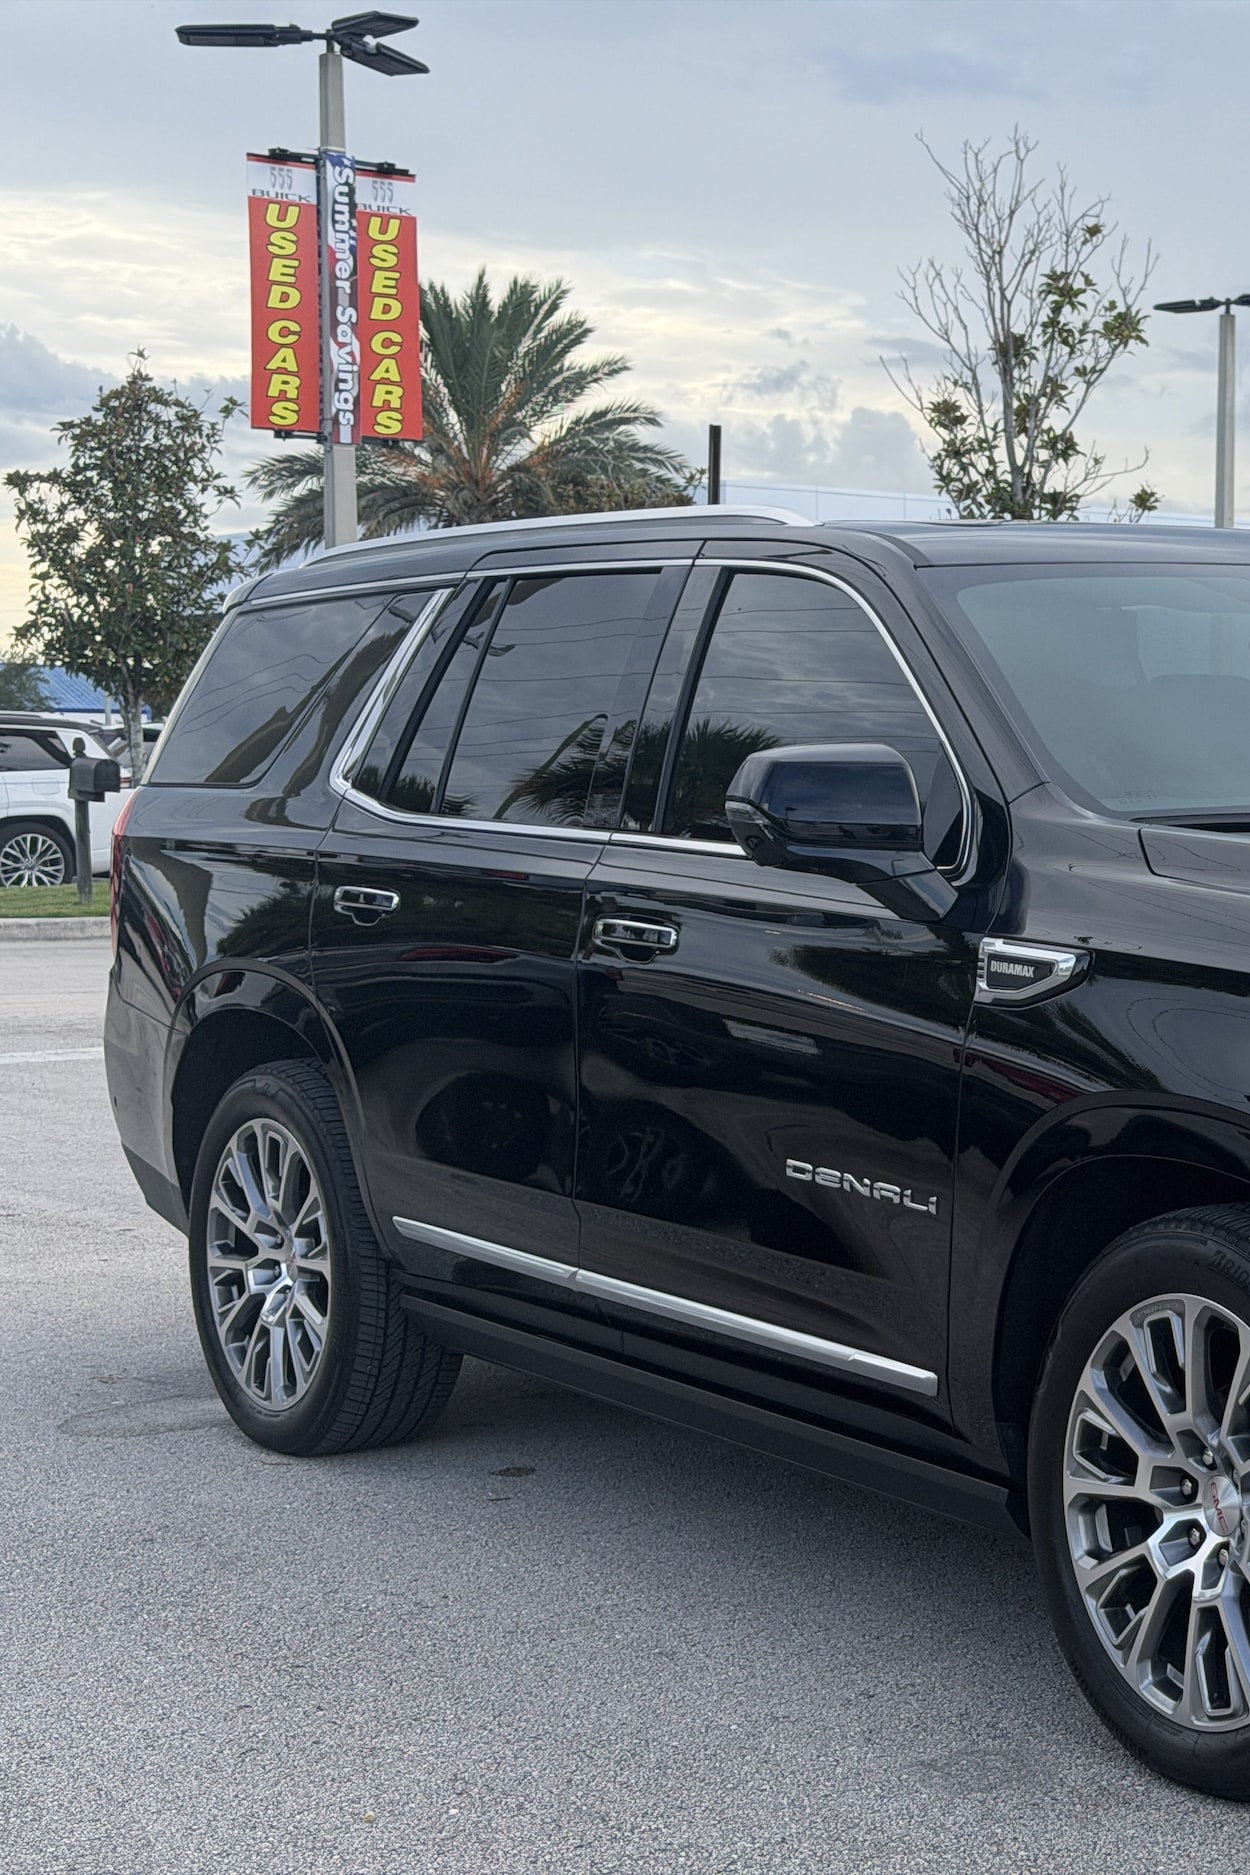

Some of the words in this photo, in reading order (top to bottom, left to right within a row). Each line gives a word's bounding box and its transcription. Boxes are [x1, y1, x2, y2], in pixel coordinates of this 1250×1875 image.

[252, 188, 312, 204] BUICK
[333, 165, 356, 294] Summer
[265, 202, 302, 310] USED
[366, 215, 403, 322] USED
[264, 319, 302, 426] CARS
[334, 306, 359, 427] Savings
[367, 330, 404, 435] CARS
[990, 960, 1035, 978] DURAMAX
[785, 1158, 938, 1216] DENALI
[1210, 1481, 1231, 1532] GMC
